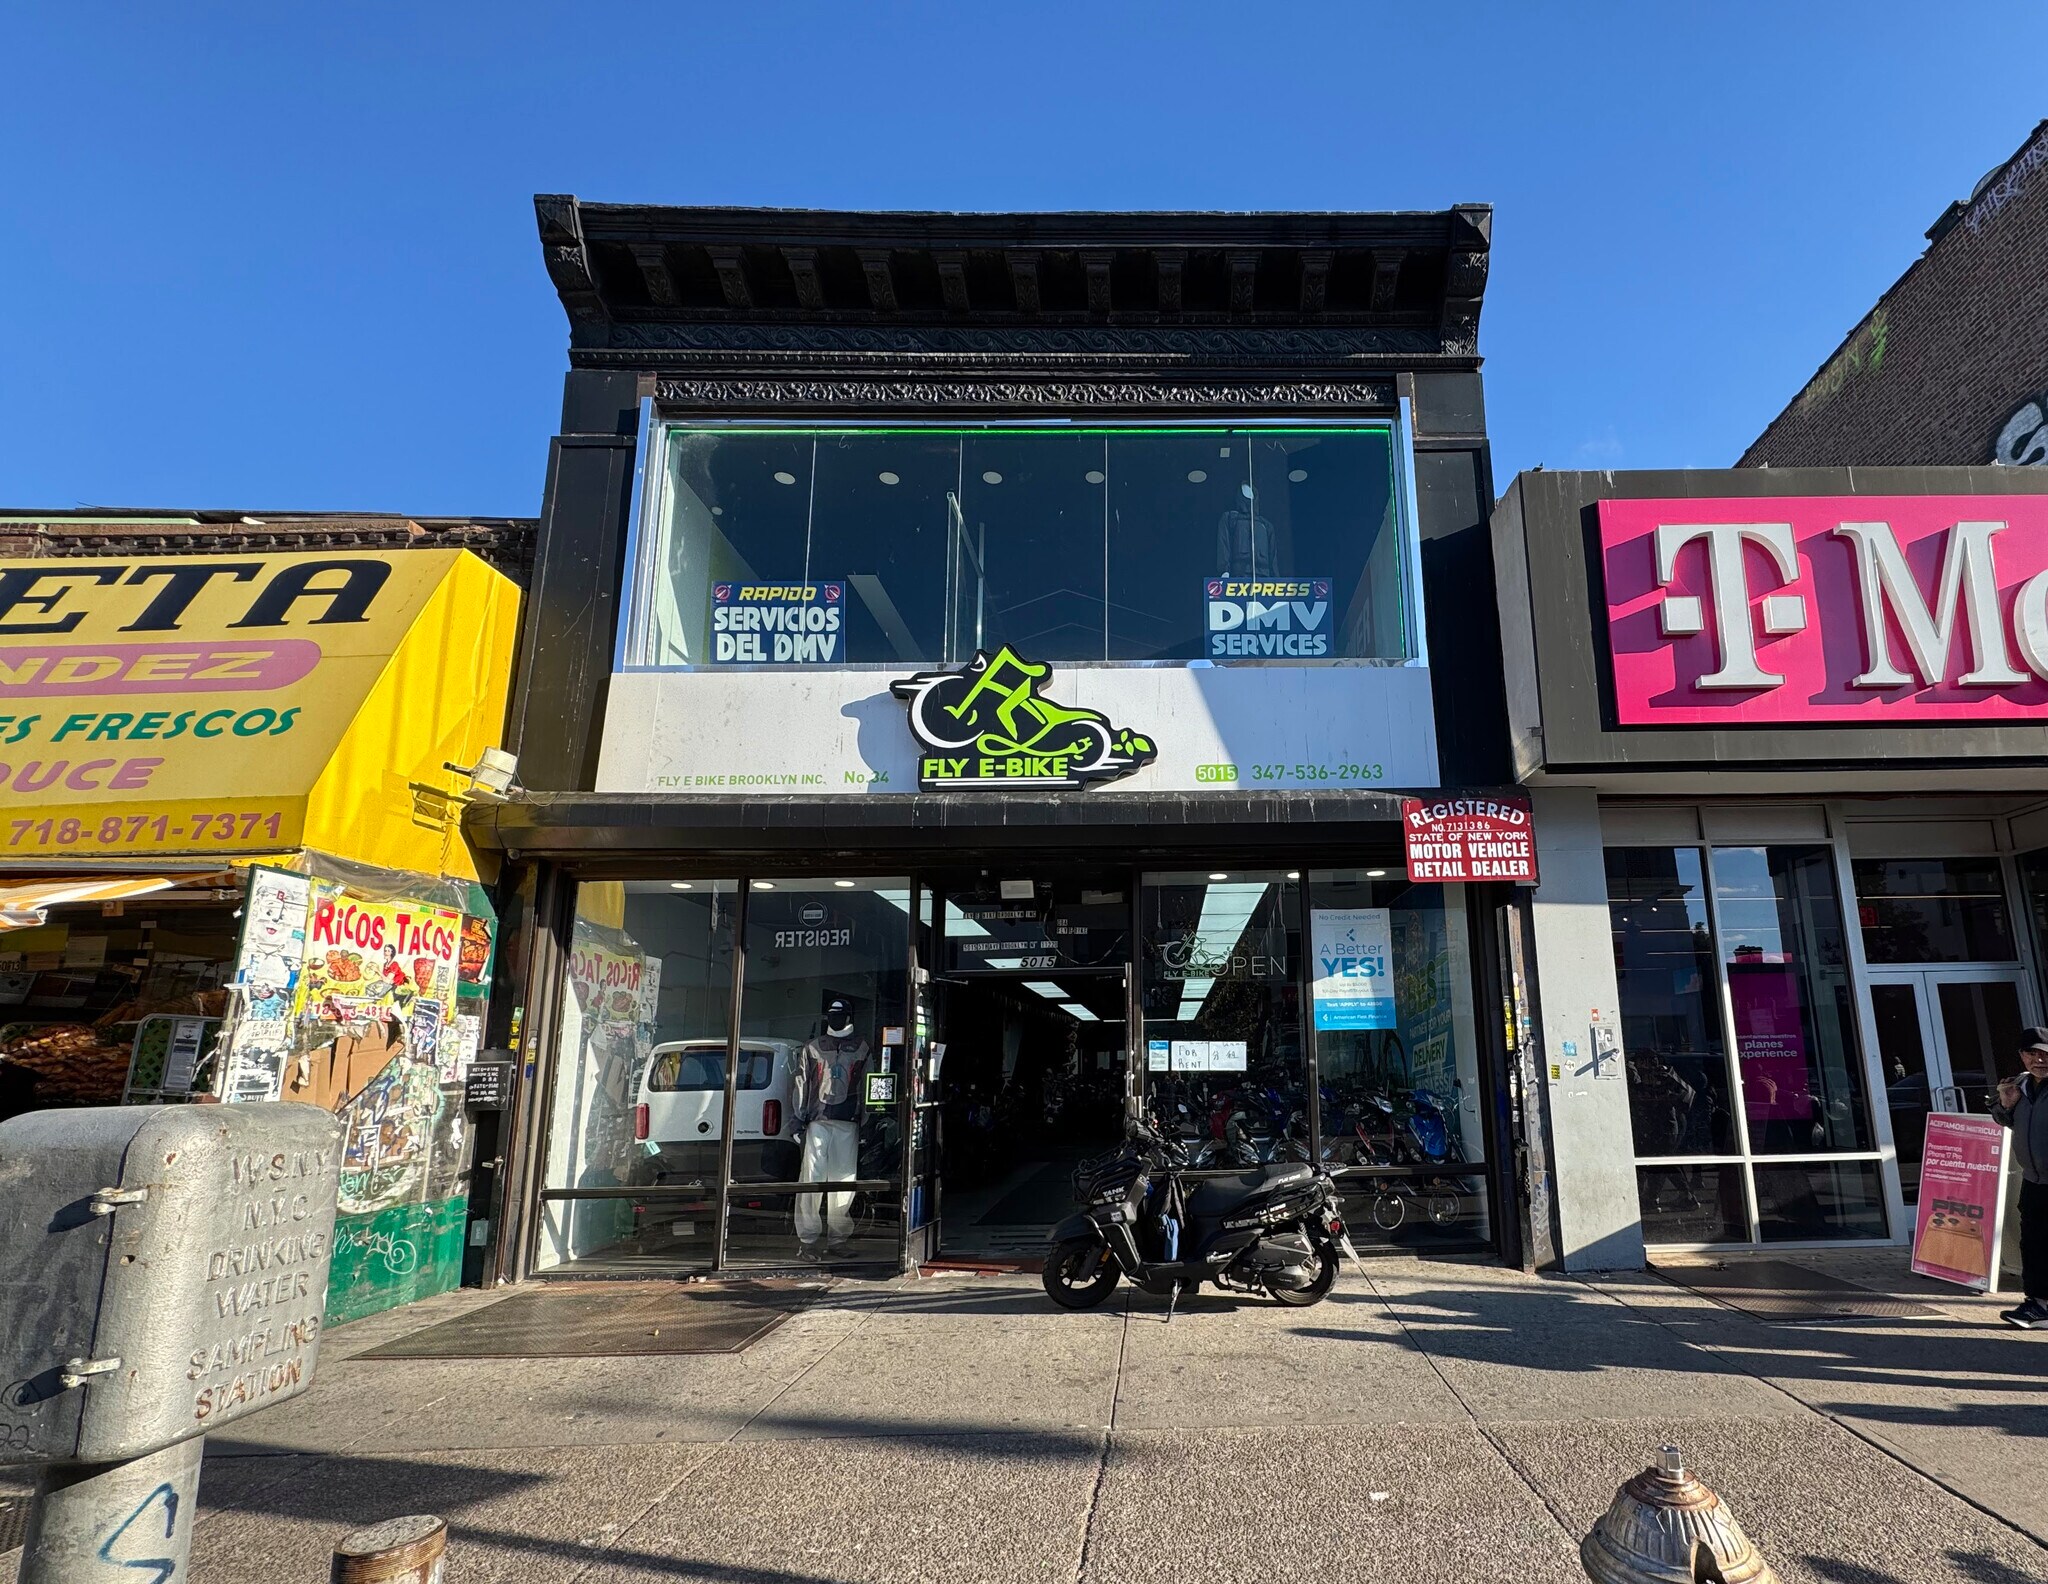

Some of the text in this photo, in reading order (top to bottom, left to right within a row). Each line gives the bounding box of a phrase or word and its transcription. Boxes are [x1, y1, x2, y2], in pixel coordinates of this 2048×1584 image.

[739, 587, 817, 600] RAPIDO
[1225, 583, 1310, 597] EXPRESS
[714, 607, 840, 632] SERVICIOS
[1209, 602, 1328, 630] DMV
[716, 634, 836, 662] DEL DMV
[1212, 634, 1326, 656] SERVICES
[50, 707, 301, 742] FRESCOS
[923, 757, 1068, 778] FLY E-BIKE
[1196, 766, 1236, 780] 5015
[1252, 764, 1383, 780] 347-536-2963
[658, 776, 680, 786] FLY
[684, 776, 690, 786] E
[695, 776, 725, 786] BIKE
[729, 774, 797, 785] BROOKLYN
[1409, 800, 1525, 828] REGISTERED
[9, 812, 282, 845] 718-871-7371
[1409, 832, 1528, 842] STATE OF NEW YORK
[1410, 842, 1530, 859] MOTOR VEHICLE
[1414, 860, 1529, 878] RETAIL DEALER
[396, 913, 454, 961] TACOS
[1320, 943, 1383, 955] A Better
[1020, 956, 1056, 968] 5015
[1210, 956, 1286, 976] OPEN
[1320, 957, 1385, 978] YES!
[1178, 1046, 1197, 1056] FOR
[1744, 1040, 1784, 1050] planes
[1178, 1058, 1202, 1069] RENT
[1930, 1120, 1965, 1132] ACEPTAMOS
[1928, 1142, 1962, 1152] Presentamos
[1926, 1158, 1998, 1172] por cuenta nuestra
[1932, 1199, 1984, 1219] PRO
[206, 1233, 325, 1282] DRINKING
[215, 1270, 310, 1318] WATER
[186, 1316, 319, 1381] SAMPLING
[194, 1356, 302, 1420] STATION
